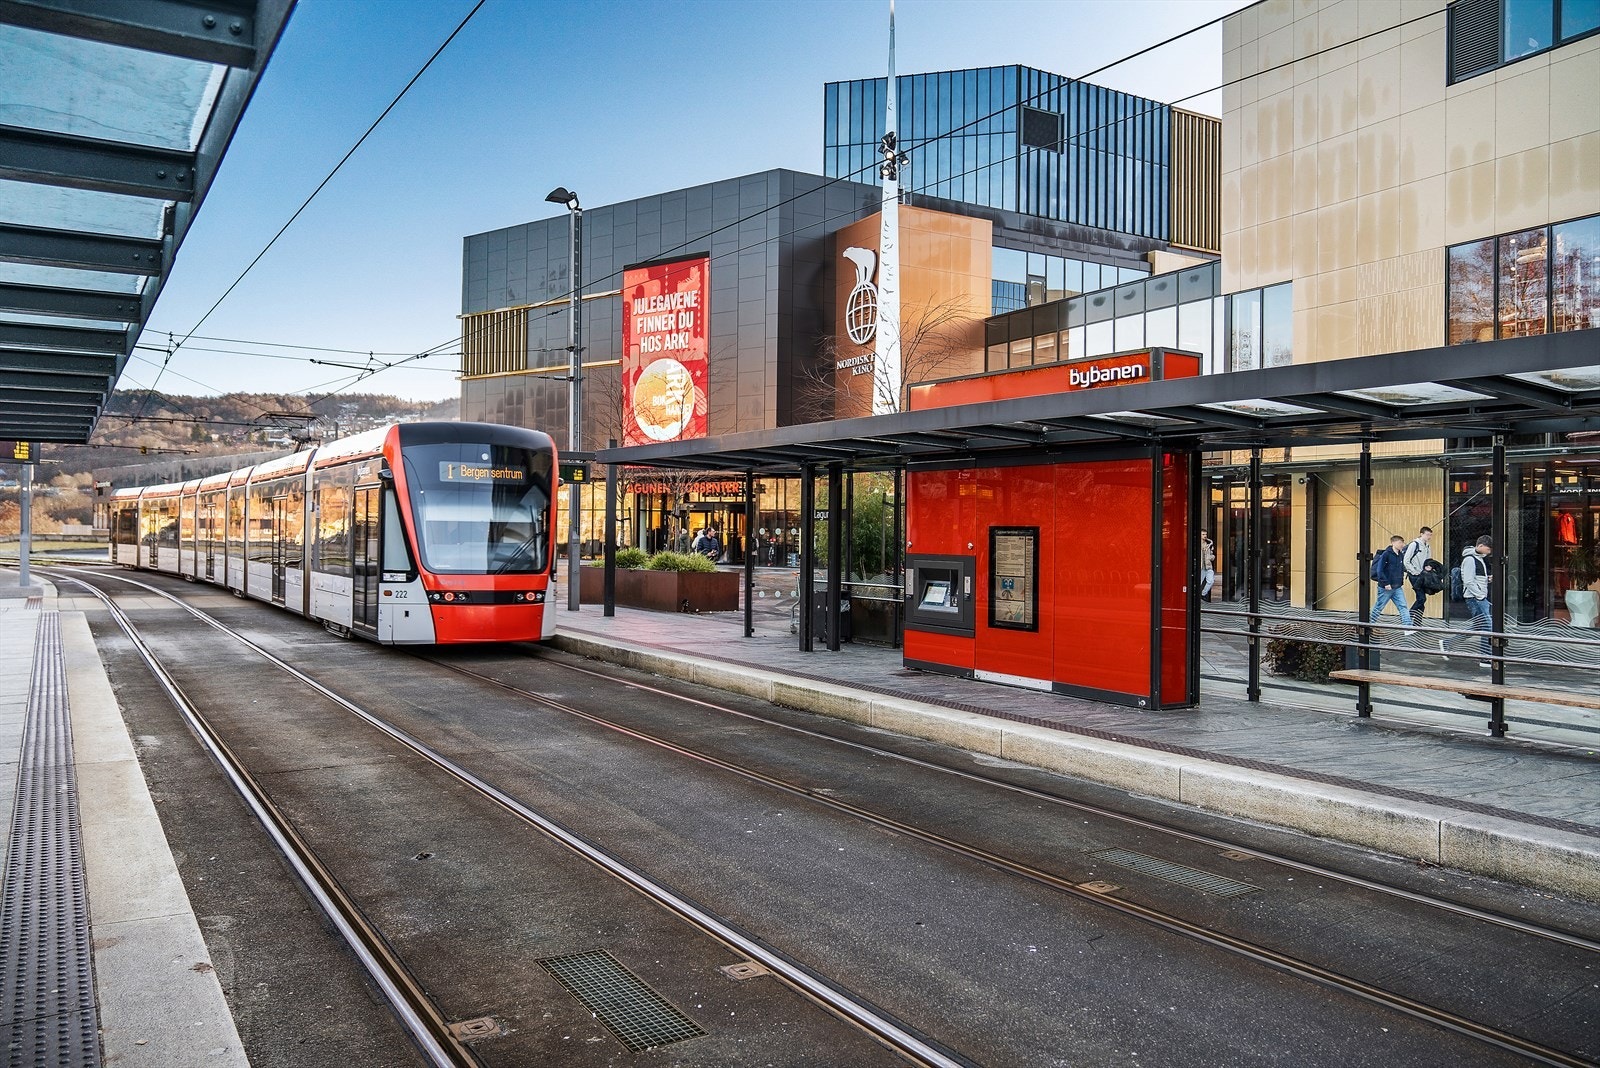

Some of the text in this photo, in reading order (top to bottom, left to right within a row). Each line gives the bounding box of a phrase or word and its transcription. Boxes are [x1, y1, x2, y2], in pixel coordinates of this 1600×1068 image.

[633, 290, 698, 316] JULEGAVENE
[637, 311, 694, 334] FINNER DU
[640, 332, 689, 353] HOS ARK!
[837, 354, 870, 369] NORDISK
[852, 364, 873, 376] KINO
[1069, 364, 1143, 388] bybanen
[447, 464, 523, 480] 1 Bergen sentrum
[395, 590, 408, 599] 222
